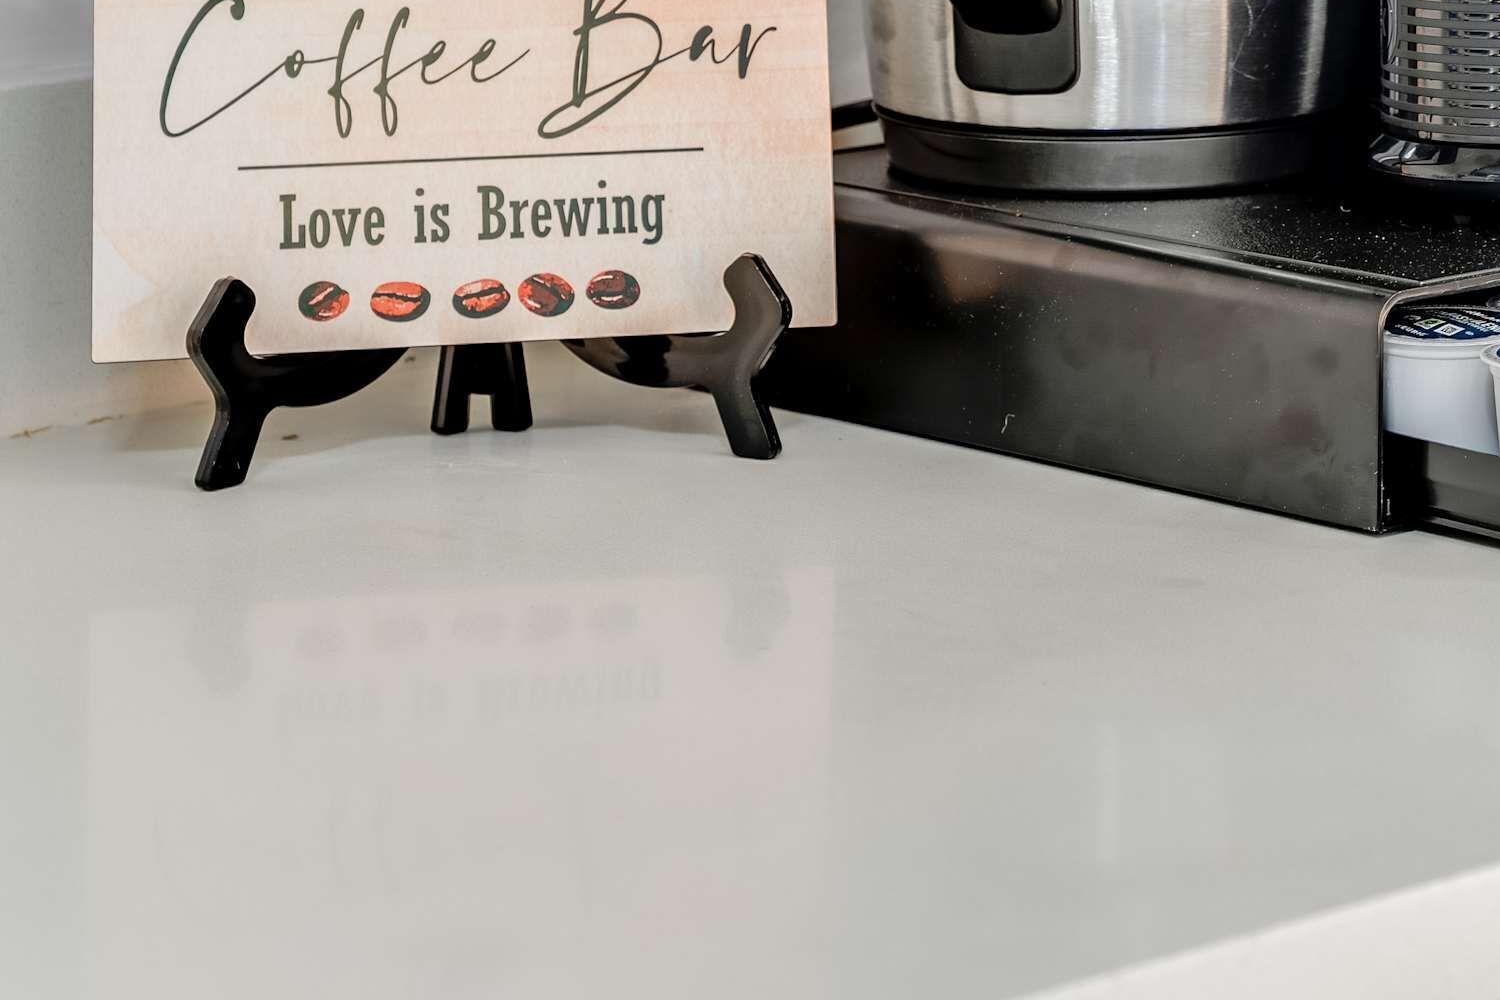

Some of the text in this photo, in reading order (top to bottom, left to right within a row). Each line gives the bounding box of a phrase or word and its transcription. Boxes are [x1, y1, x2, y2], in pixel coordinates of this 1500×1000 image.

[278, 179, 666, 250] Love is Brewing
